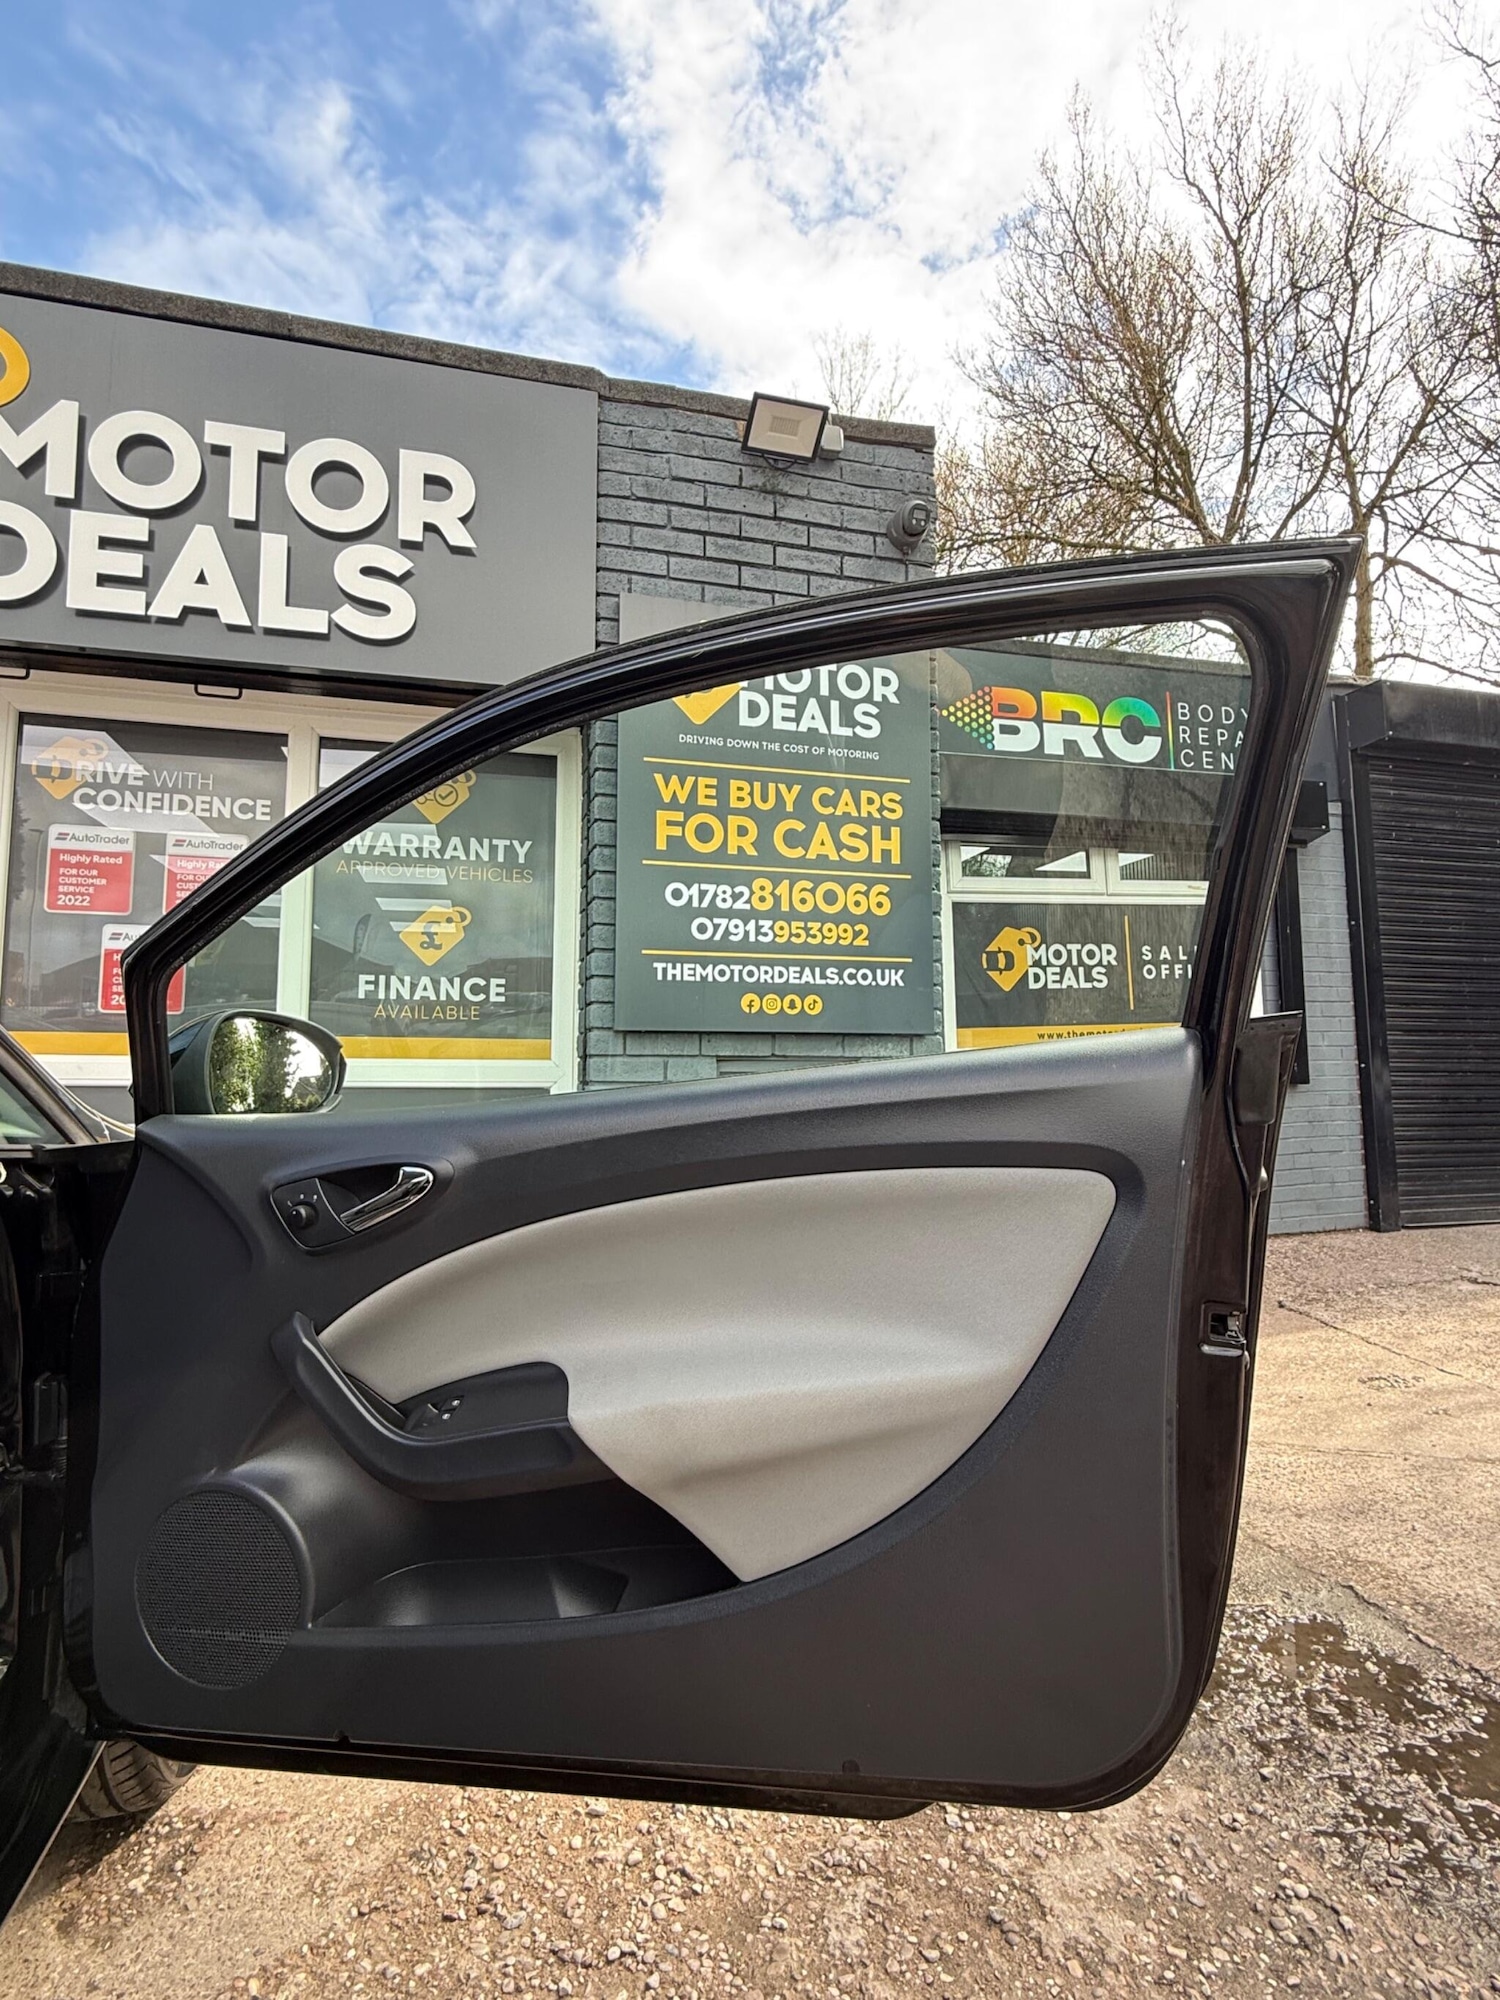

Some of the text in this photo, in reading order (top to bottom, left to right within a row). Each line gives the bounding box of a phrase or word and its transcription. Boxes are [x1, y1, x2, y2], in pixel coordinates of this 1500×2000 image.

[0, 399, 477, 549] MOTOR
[738, 690, 882, 739] DEALS
[990, 686, 1163, 764] BRC
[678, 733, 880, 761] DRIVING DOWN THE COST OF MOTORING
[1179, 725, 1244, 748] REPA
[1180, 749, 1234, 770] CEN
[152, 769, 214, 791] WITH
[72, 787, 272, 821] CONFIDENCE
[653, 773, 904, 820] WE BUY CARS
[69, 832, 130, 845] AutoTrader
[341, 831, 533, 864] WARRANTY
[655, 809, 901, 865] FOR CASH
[59, 853, 123, 865] Highly Rated
[176, 859, 207, 870] Highly
[58, 876, 107, 886] CUSTOMER
[59, 867, 98, 877] FOR OUR
[176, 873, 195, 881] FOR
[336, 860, 533, 884] APPROVED VEHICLES
[57, 885, 95, 894] SERVICE
[57, 894, 91, 906] 2022
[1026, 943, 1118, 966] MOTOR
[653, 962, 905, 987] THEMOTORDEALS.CO.UK
[1028, 966, 1109, 990] DEALS
[1142, 963, 1193, 980] OFFI
[358, 974, 507, 1003] FINANCE
[374, 1004, 481, 1020] AVAILABLE
